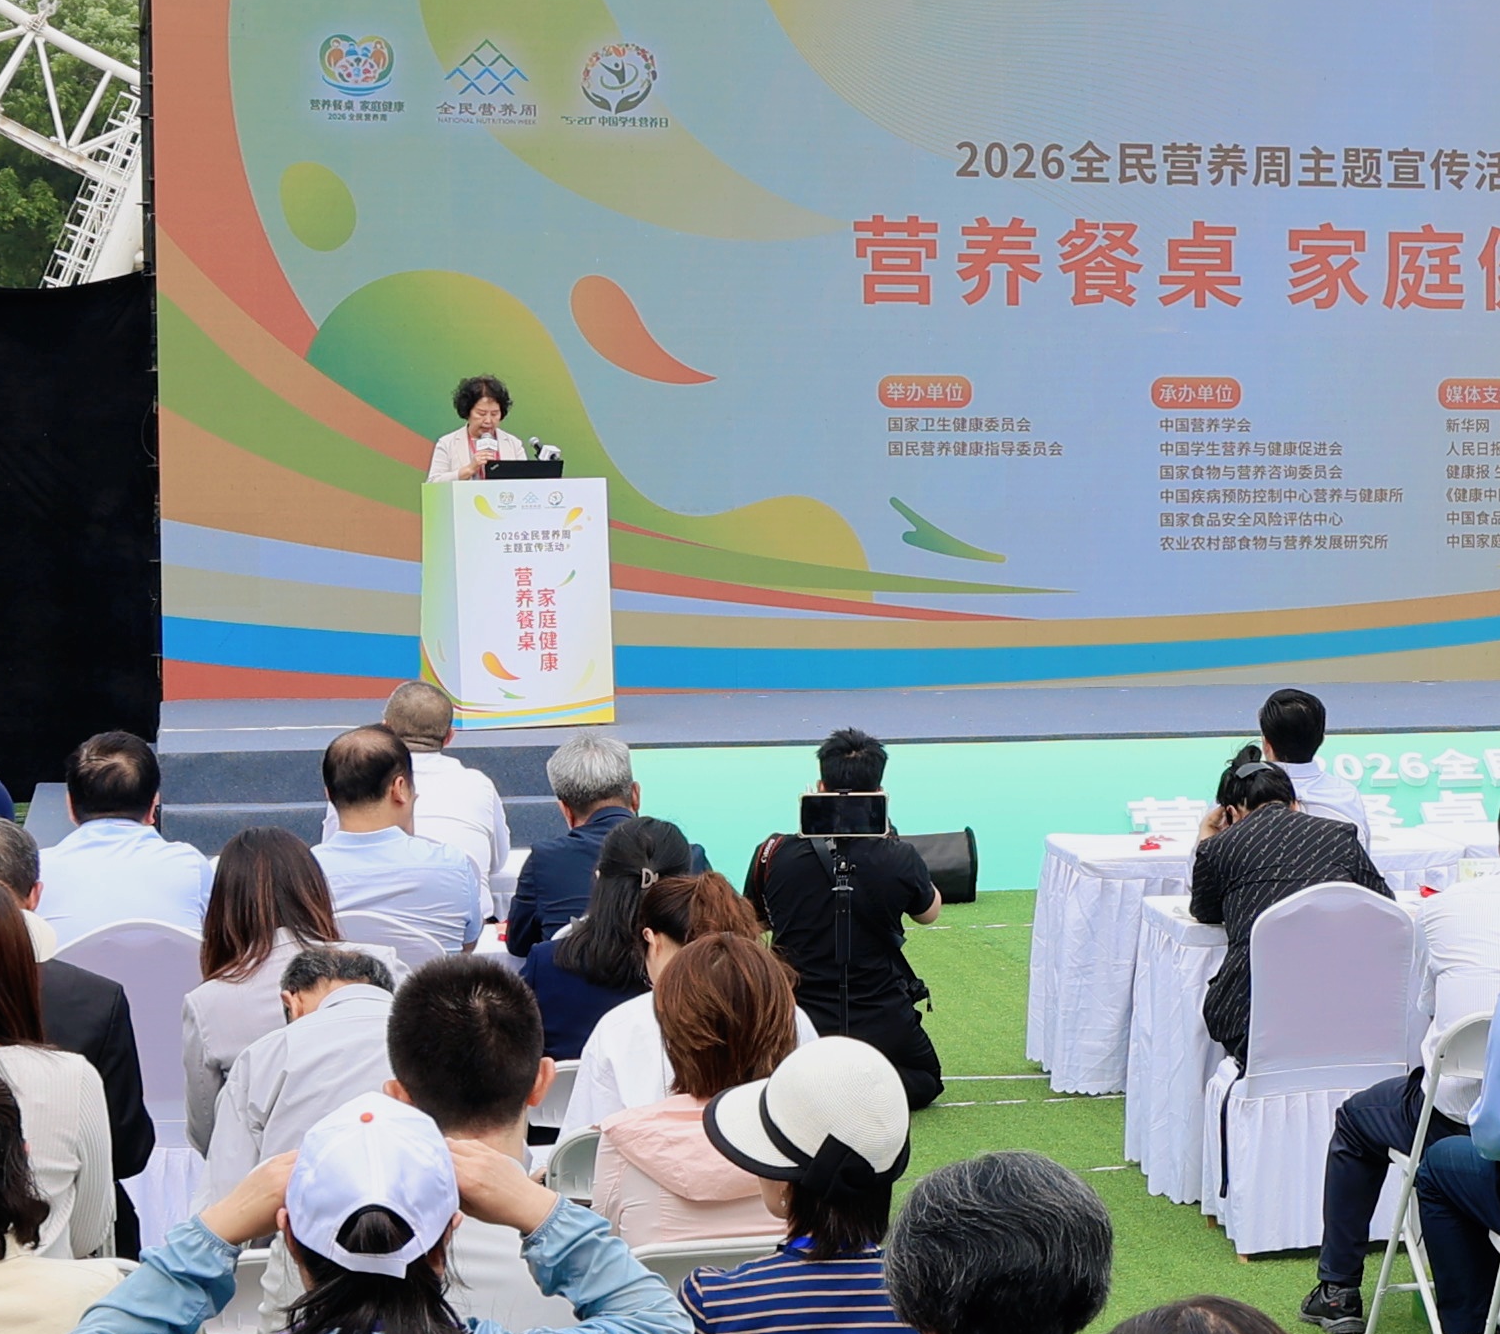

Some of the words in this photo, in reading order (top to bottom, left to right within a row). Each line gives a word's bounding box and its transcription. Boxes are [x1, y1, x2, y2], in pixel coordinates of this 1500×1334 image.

[309, 99, 355, 111] 营养餐桌
[359, 100, 405, 113] 家庭健康
[436, 102, 537, 117] 全民营养周
[853, 215, 1242, 307] 营养餐桌
[886, 382, 964, 402] 举办单位
[1159, 384, 1233, 403] 承办单位
[887, 417, 1032, 433] 国家卫生健康委员会
[1159, 417, 1252, 433] 中国营养学会
[1445, 418, 1490, 433] 新华网
[887, 441, 1063, 457] 国民营养健康指导委员会
[1159, 441, 1343, 457] 中国学生营养与健康促进会
[1159, 464, 1343, 480] 国家食物与营养咨询委员会
[1446, 464, 1490, 480] 健康报
[1159, 488, 1404, 504] 中国疾病预防控制中心营养与健康所
[1159, 511, 1343, 528] 国家食品安全风险评估中心
[494, 529, 571, 541] 2026全民营养周
[1159, 534, 1388, 551] 农业农村部食物与营养发展研究所
[502, 542, 565, 553] 主题宣传活动
[514, 567, 536, 651] 营养餐桌
[537, 588, 558, 672] 家庭健康
